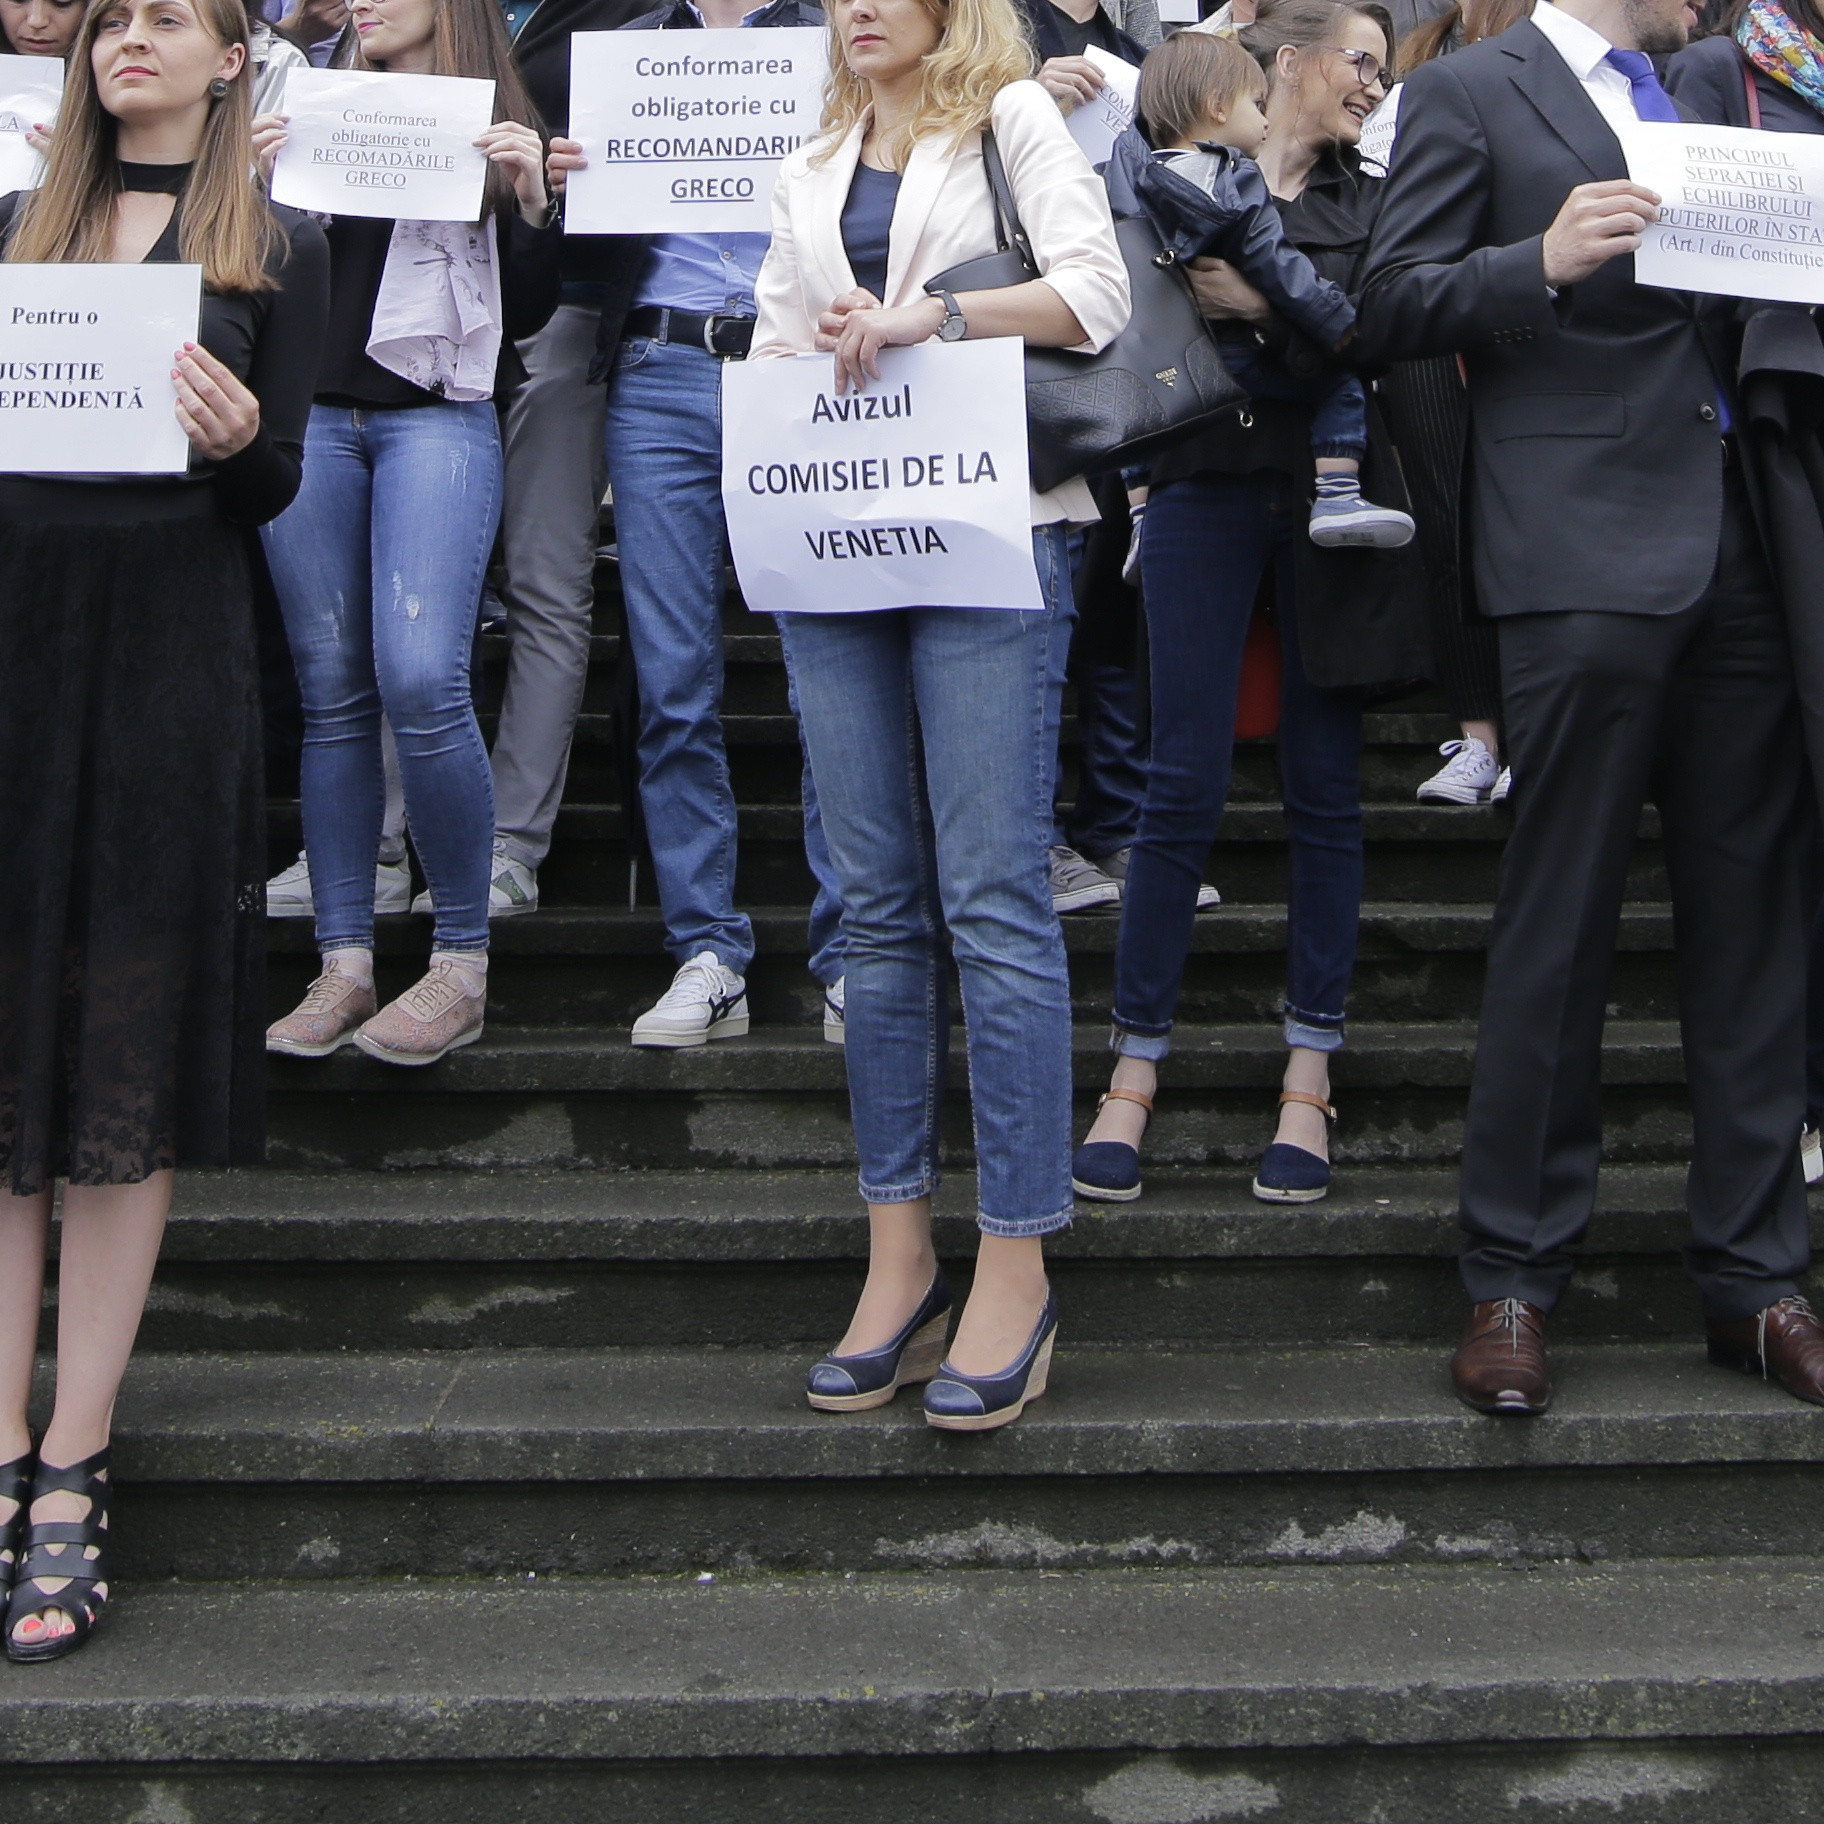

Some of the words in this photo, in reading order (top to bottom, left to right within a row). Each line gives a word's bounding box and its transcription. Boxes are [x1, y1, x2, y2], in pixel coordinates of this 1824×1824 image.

[635, 55, 793, 77] Conformarea
[343, 109, 438, 127] Conformarea
[631, 96, 762, 121] obligatorie
[769, 99, 796, 115] cu
[331, 129, 410, 148] obligatorie
[414, 138, 431, 147] cu
[1685, 145, 1795, 167] PRINCIPIUL
[345, 171, 407, 187] GRECO
[671, 177, 755, 199] GRECO
[1682, 187, 1812, 217] ECHILIBRULUI
[1658, 207, 1759, 236] PUTERILOR
[1765, 217, 1784, 238] ÎN
[1710, 240, 1735, 258] din
[11, 307, 79, 325] Pentru
[87, 312, 98, 325] o
[811, 384, 912, 424] Avizul
[748, 458, 890, 495] COMISIEI
[903, 455, 944, 487] DE
[957, 451, 998, 484] LA
[804, 526, 948, 560] VENETIA
